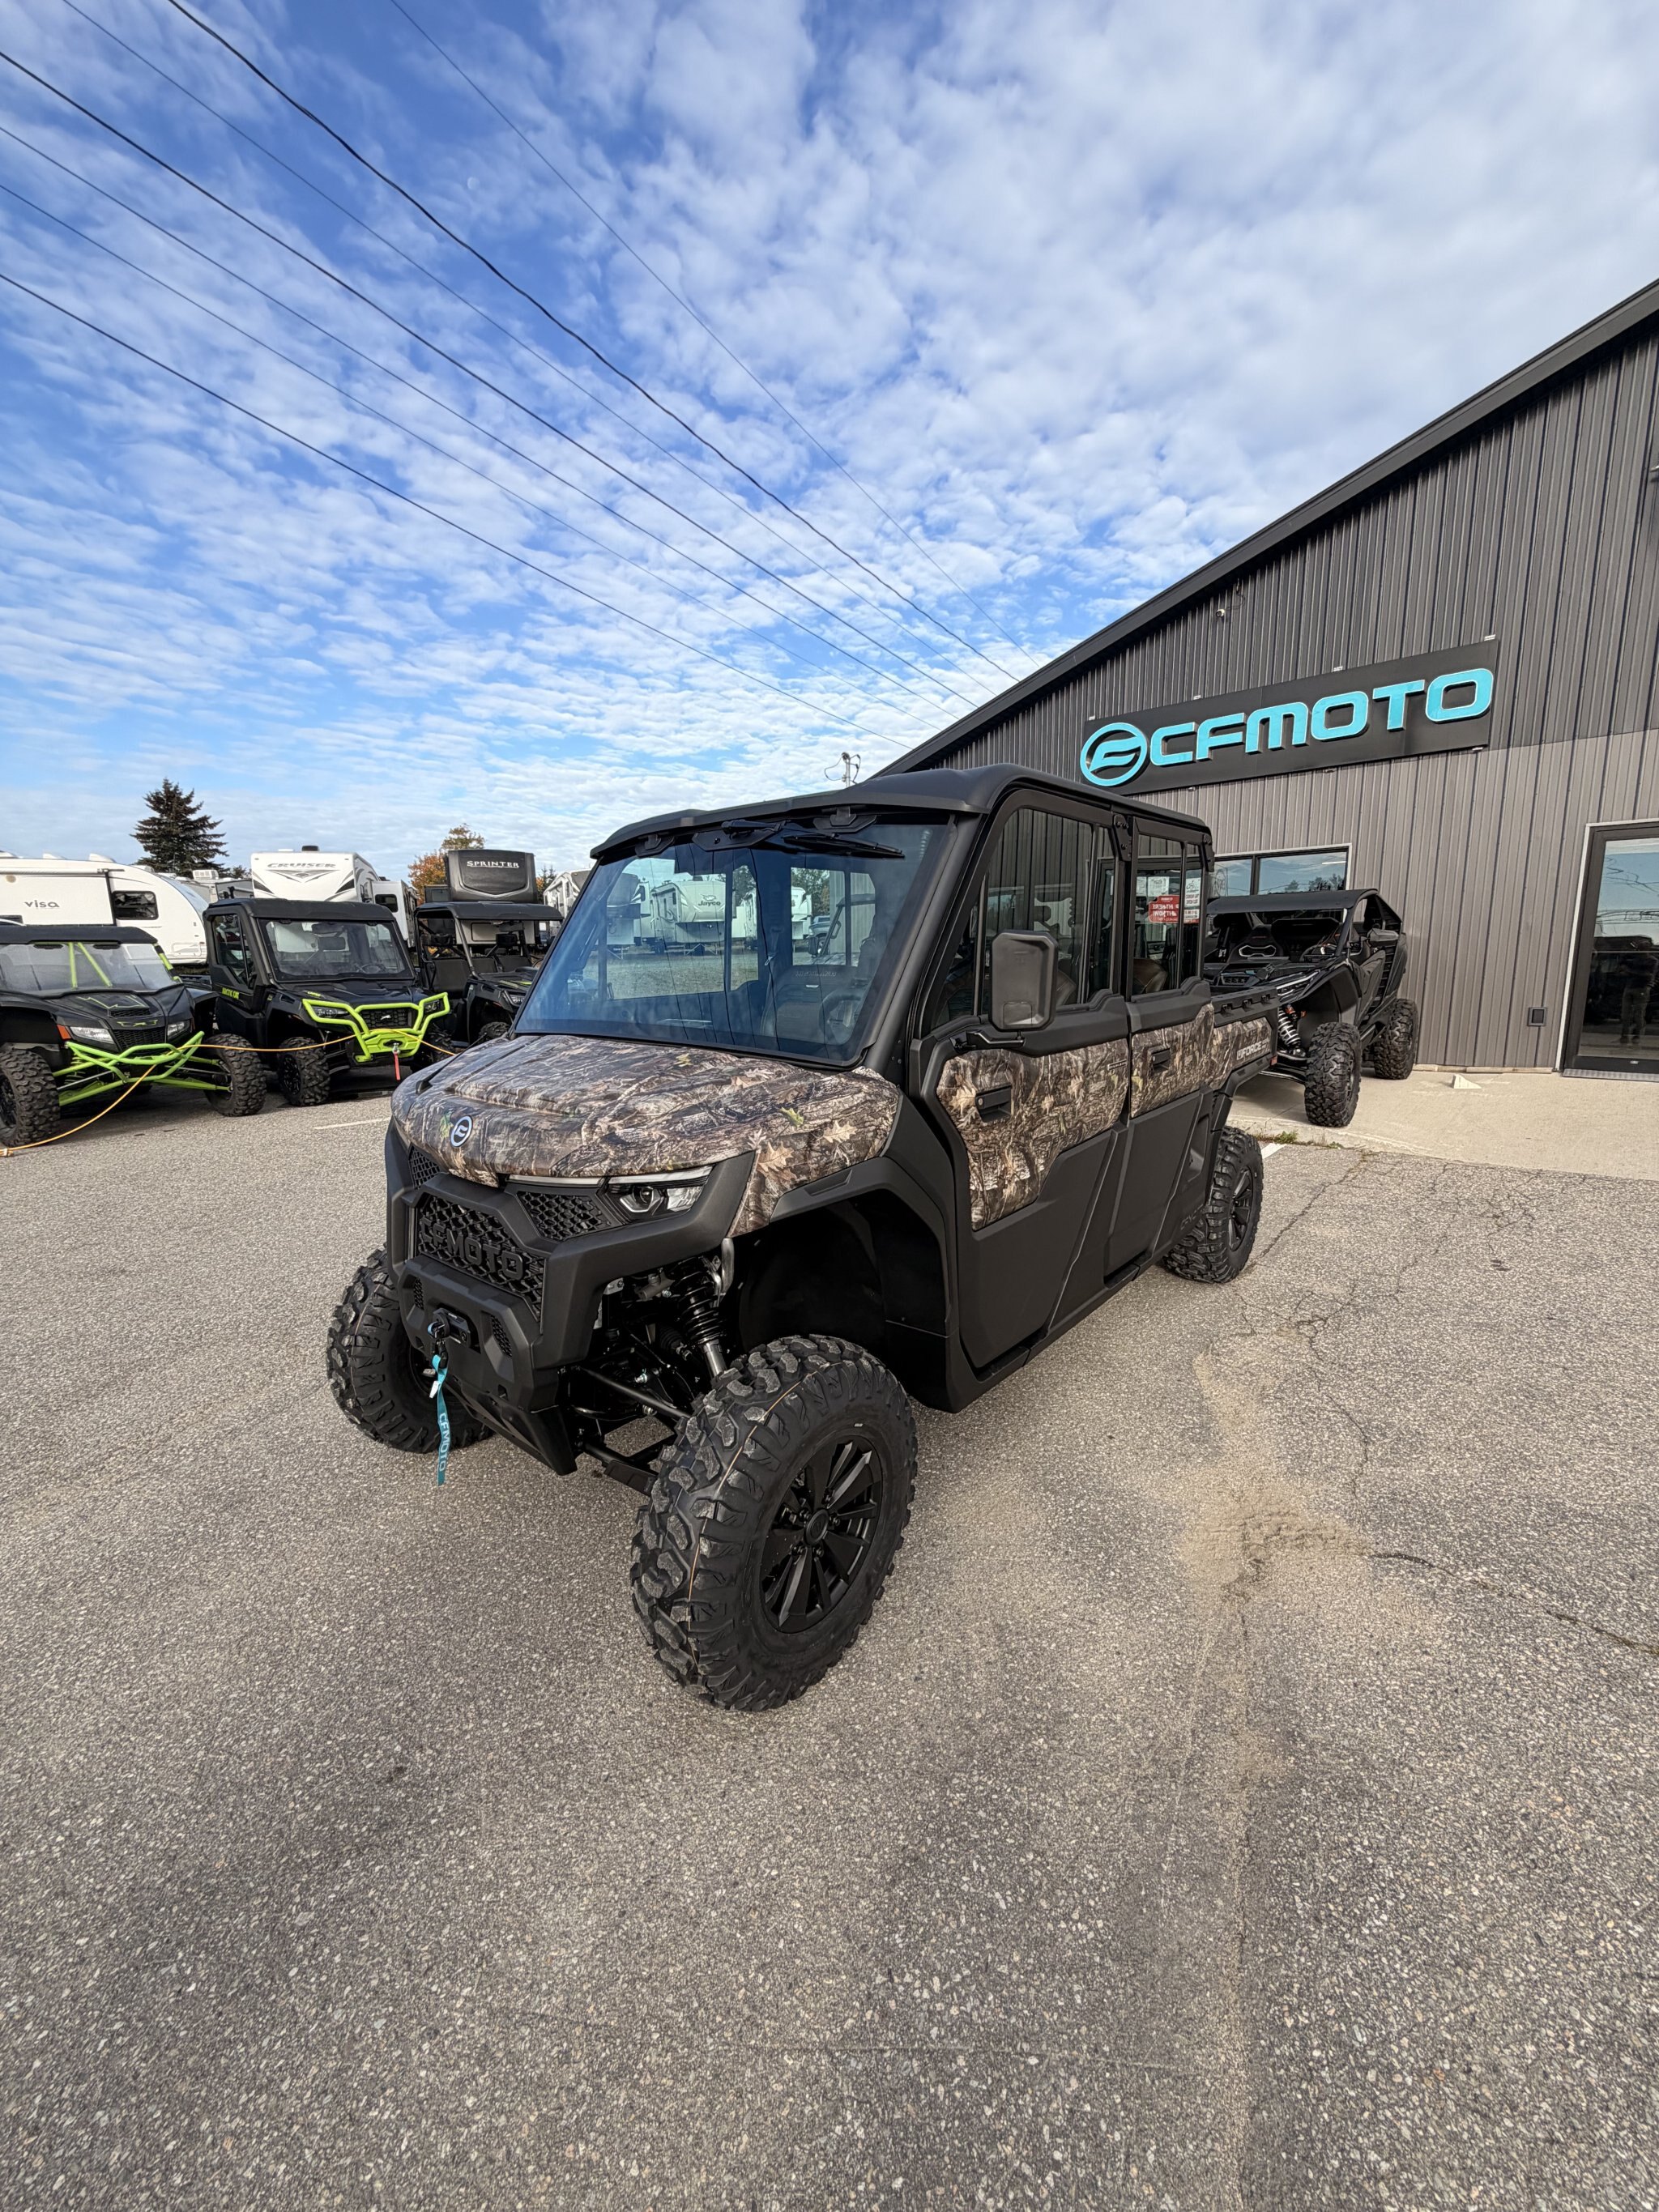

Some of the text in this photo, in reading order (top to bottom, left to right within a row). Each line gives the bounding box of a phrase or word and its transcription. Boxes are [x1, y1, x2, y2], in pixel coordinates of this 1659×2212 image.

[1150, 667, 1495, 765] CFMOTO
[467, 860, 519, 869] SPRINTER
[24, 900, 60, 908] visa
[222, 987, 232, 997] ARCTIC
[420, 1217, 523, 1281] CFMOTO
[439, 1413, 450, 1472] CFMOTO
